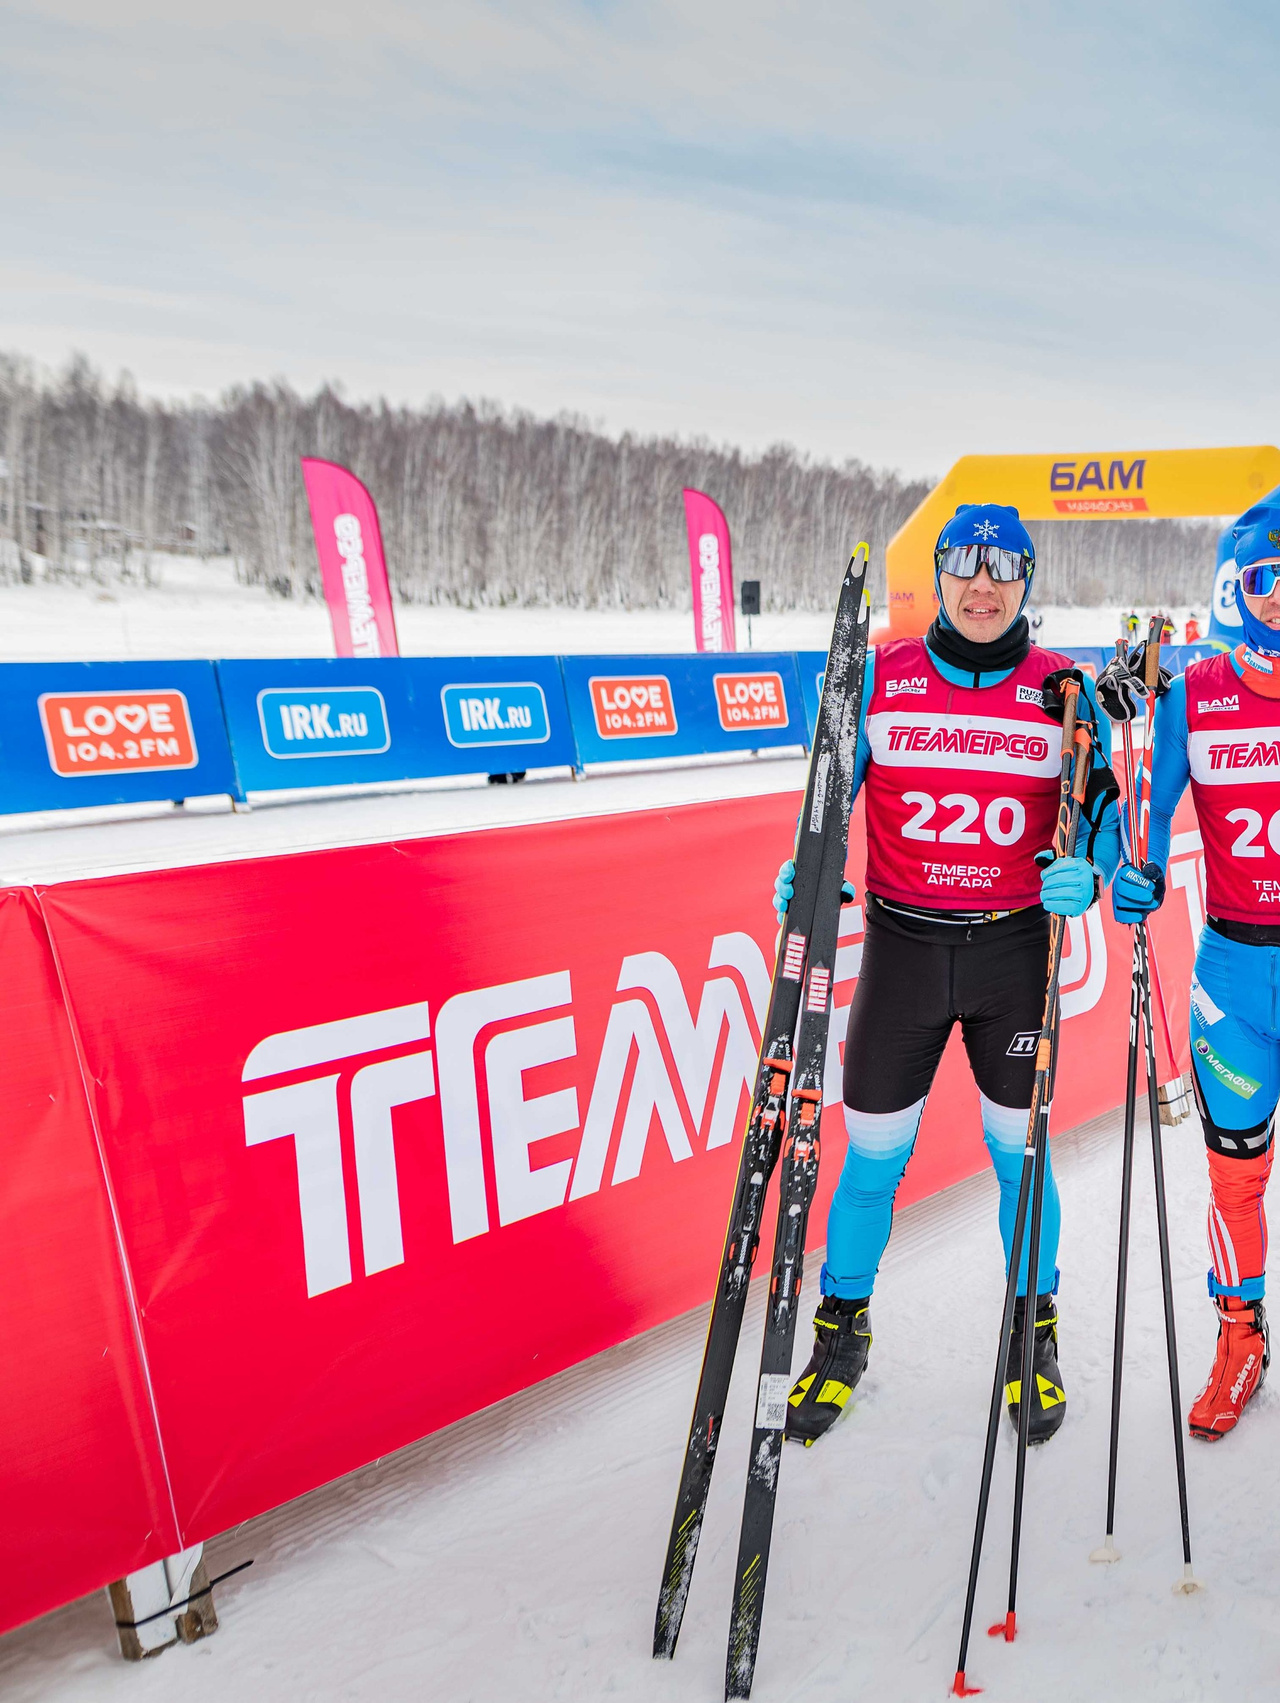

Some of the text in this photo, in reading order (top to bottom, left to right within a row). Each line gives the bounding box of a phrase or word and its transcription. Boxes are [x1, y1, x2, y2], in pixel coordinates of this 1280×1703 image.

[1050, 459, 1147, 492] БАМ
[885, 676, 928, 691] БАМ
[1197, 694, 1239, 709] БАМ
[901, 790, 1026, 847] 220
[922, 862, 1002, 878] ТЕМЕРСО
[1126, 869, 1151, 889] RUSSIA
[927, 875, 993, 889] АНГАРА
[1205, 1052, 1258, 1095] МЕГАФОН
[1229, 1352, 1256, 1405] alpina
